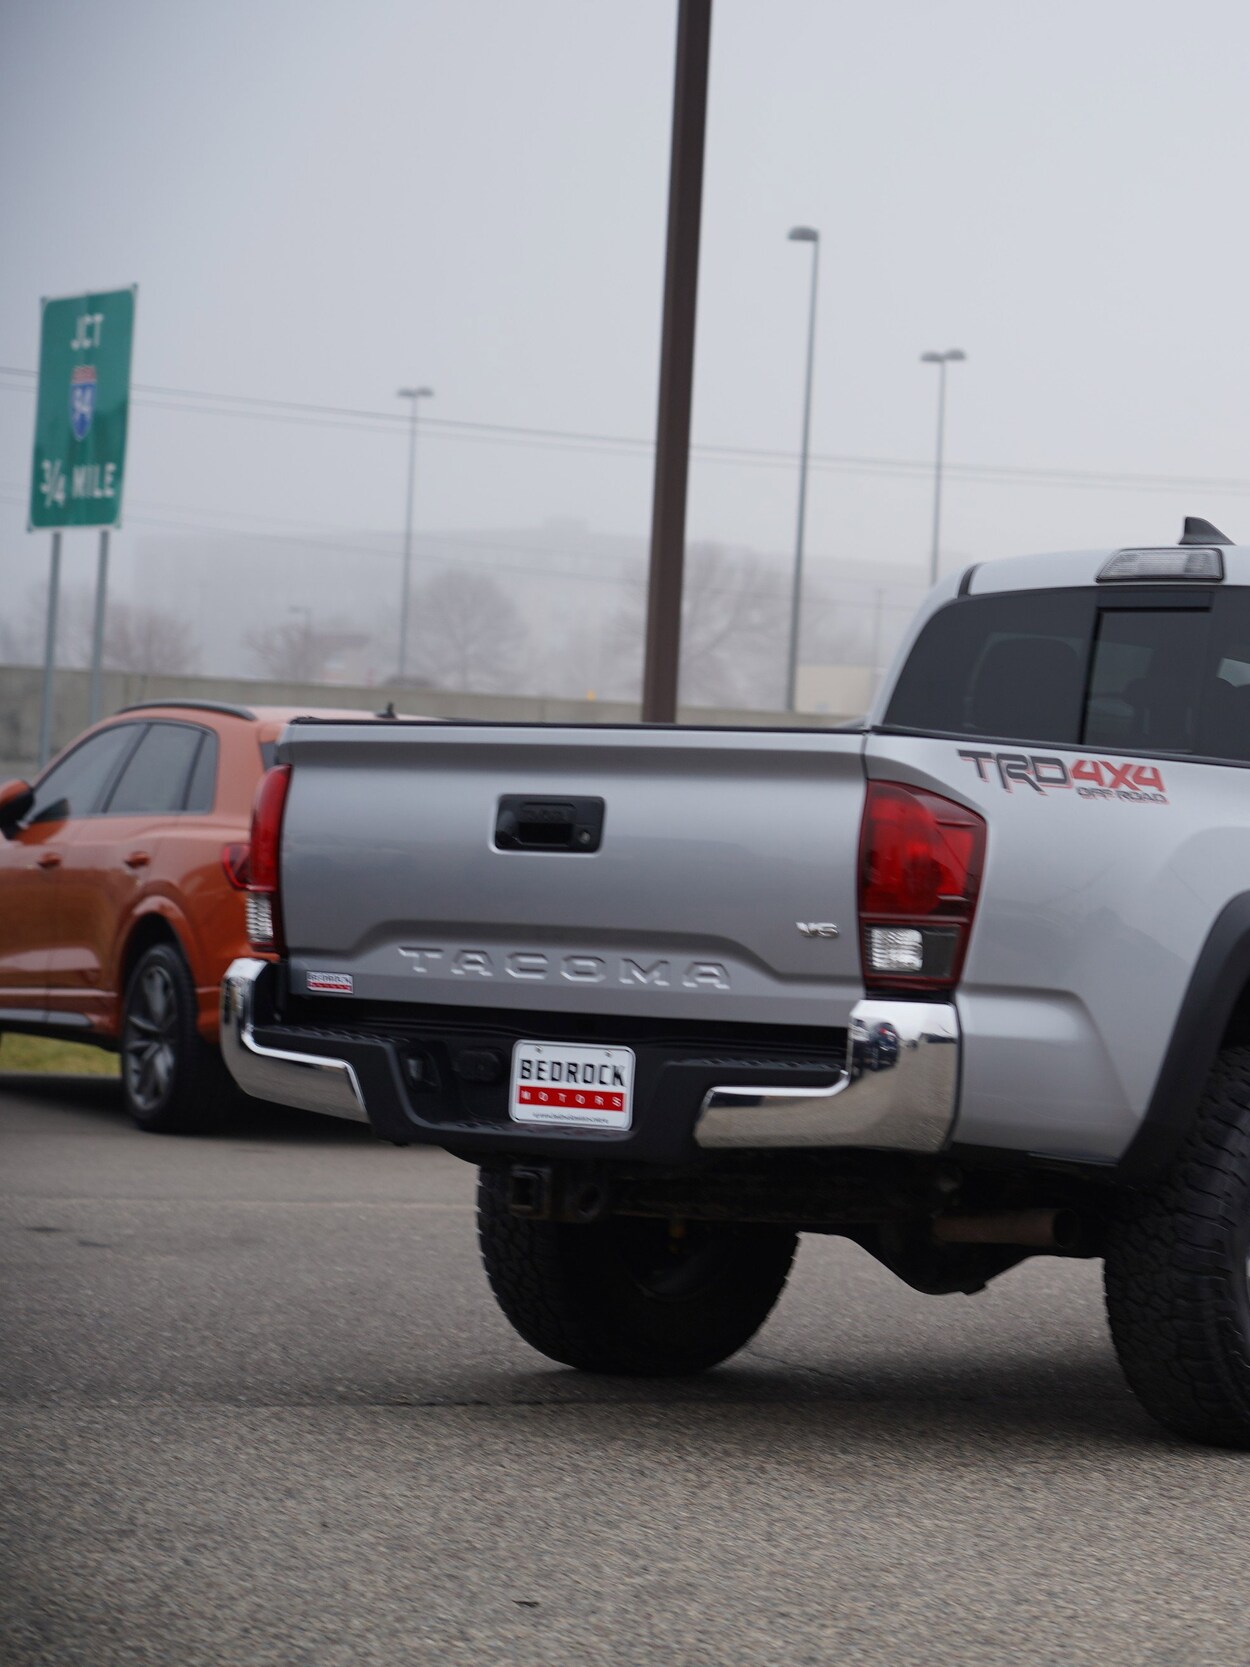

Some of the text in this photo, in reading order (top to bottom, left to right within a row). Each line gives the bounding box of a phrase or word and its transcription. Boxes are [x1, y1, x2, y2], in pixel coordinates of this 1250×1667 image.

[70, 312, 104, 351] JCT
[72, 462, 117, 499] MILE
[957, 749, 1167, 796] TRD 4X4
[1075, 786, 1170, 805] OFF ROAD
[796, 921, 839, 938] V6
[398, 946, 732, 990] TACOMA
[519, 1058, 626, 1087] BEDROCK
[520, 1089, 623, 1108] MOTORS
